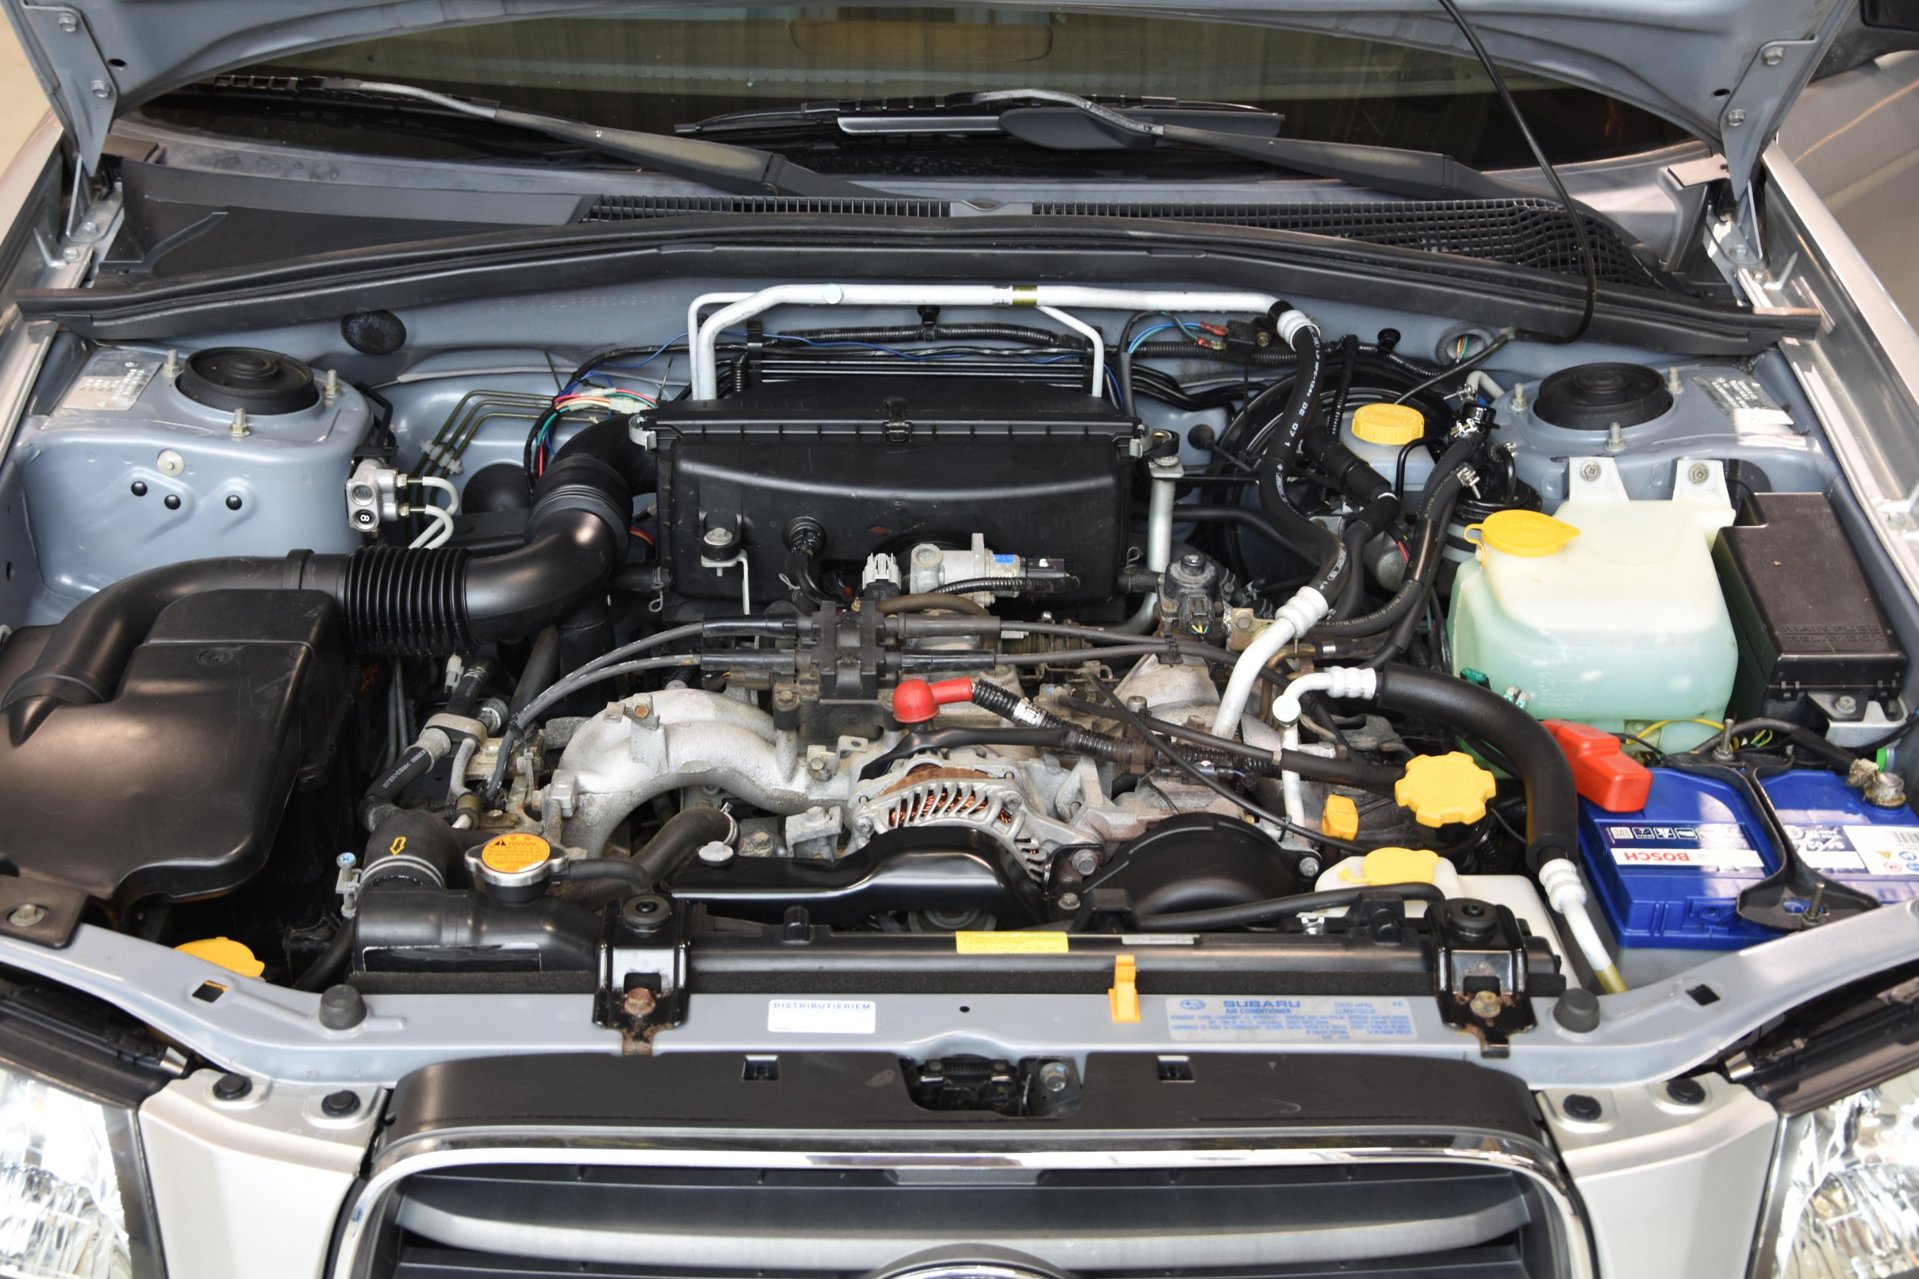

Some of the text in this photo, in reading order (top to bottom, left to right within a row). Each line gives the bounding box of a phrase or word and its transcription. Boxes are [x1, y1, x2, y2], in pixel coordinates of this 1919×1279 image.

[360, 514, 370, 522] 8
[1623, 852, 1691, 862] BOSCH
[1223, 1000, 1301, 1008] SUBARU
